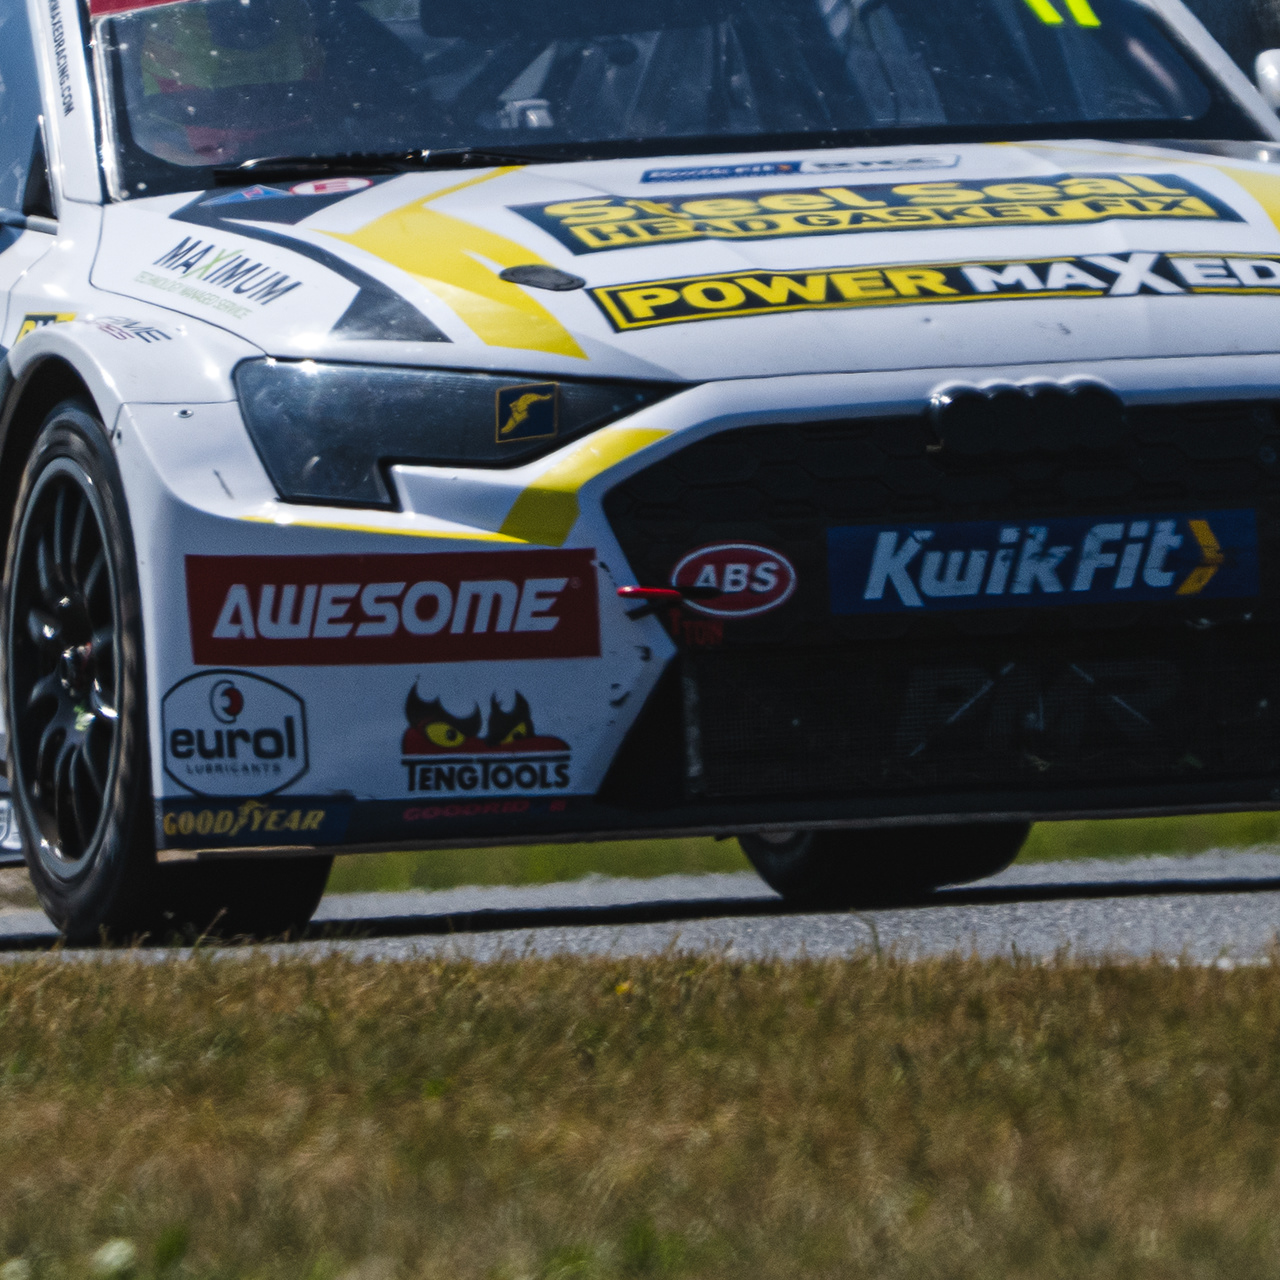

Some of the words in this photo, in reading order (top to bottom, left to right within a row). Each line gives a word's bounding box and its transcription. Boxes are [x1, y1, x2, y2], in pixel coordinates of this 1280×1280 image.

[543, 187, 888, 225] Steel
[892, 174, 1190, 204] Seal
[586, 218, 780, 243] HEAD
[792, 203, 1070, 228] GASKET
[1086, 196, 1192, 215] FIX
[152, 236, 303, 306] MAXIMUM
[619, 268, 960, 319] POWER
[694, 560, 780, 594] ABS
[211, 577, 569, 639] AWESOME
[169, 715, 297, 760] eurol
